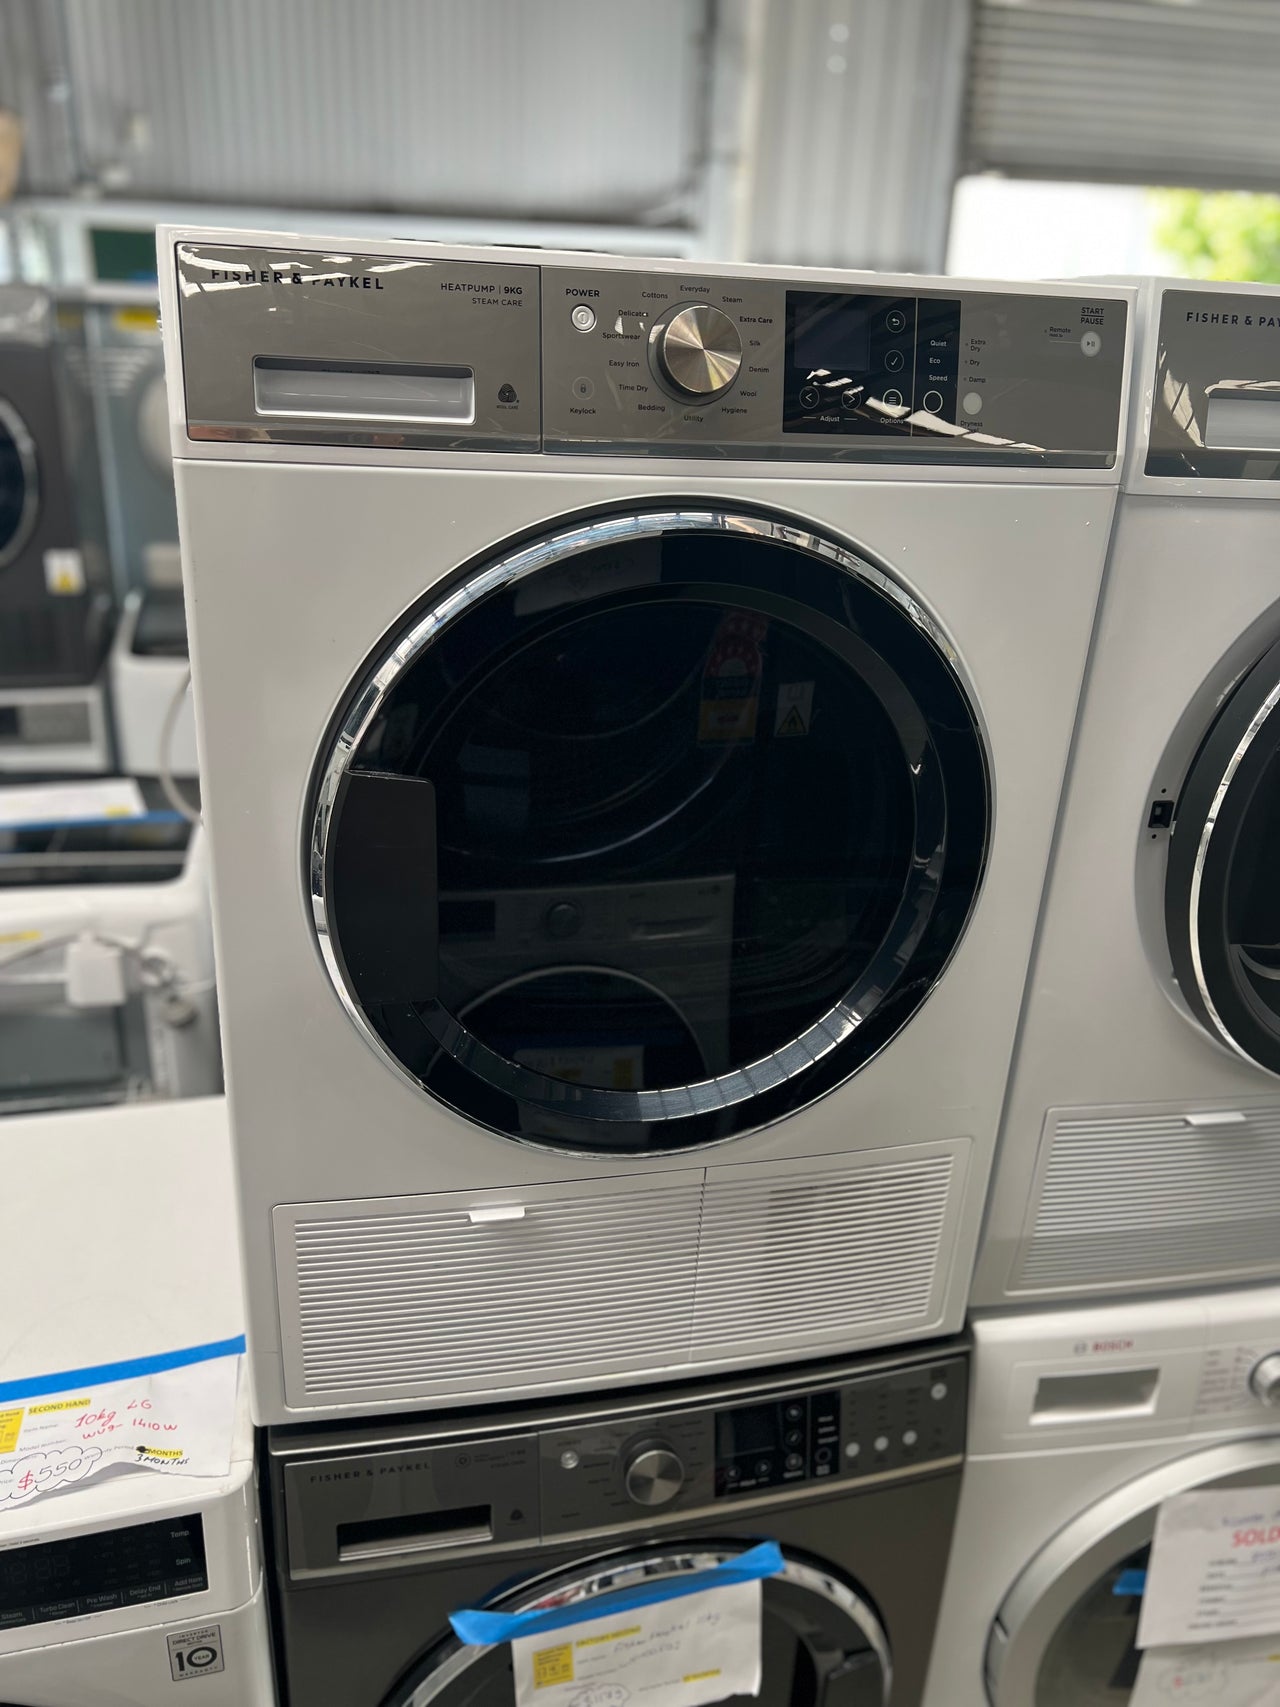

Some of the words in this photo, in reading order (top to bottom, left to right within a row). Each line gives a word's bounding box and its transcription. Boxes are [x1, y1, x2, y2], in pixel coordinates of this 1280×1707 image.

[211, 269, 284, 284] FISHER
[292, 271, 303, 285] &
[311, 273, 384, 290] PAYKEL
[440, 282, 496, 293] HEATPUMP
[503, 286, 523, 295] 9KG
[565, 288, 600, 298] POWER
[680, 284, 711, 294] Everyday
[641, 291, 669, 299] Cottons
[721, 295, 743, 303] Steam
[471, 297, 499, 305] STEAM
[501, 299, 523, 307] CARE
[618, 309, 649, 318] Delicates
[1080, 306, 1105, 315] START
[757, 316, 773, 324] Care
[1080, 317, 1104, 326] PAUSE
[1186, 311, 1239, 325] FISHER
[1244, 315, 1253, 326] &
[602, 332, 641, 341] Sportswear
[930, 339, 947, 347] Quiet
[970, 345, 981, 353] Dry
[608, 359, 625, 368] Easy
[969, 359, 980, 367] Dry
[928, 374, 948, 382] Speed
[968, 376, 986, 384] Damp
[619, 383, 635, 391] Time
[636, 384, 649, 393] Dry
[569, 407, 597, 415] Keylock
[637, 403, 666, 412] Bedding
[721, 406, 748, 415] Hygiene
[819, 415, 840, 423] Adjust
[879, 417, 905, 425] Options
[1092, 1339, 1134, 1352] BOSCH
[28, 1403, 64, 1415] SECOND
[66, 1399, 91, 1409] HAND
[17, 1457, 83, 1491] $550
[310, 1470, 361, 1483] FISHER
[380, 1462, 430, 1475] PAYKEL
[170, 1530, 190, 1538] Temp
[175, 1557, 192, 1566] Spin
[172, 1636, 195, 1646] DIRECT
[196, 1632, 216, 1640] DRIVE
[175, 1646, 218, 1672] 10
[194, 1653, 210, 1661] YEAR
